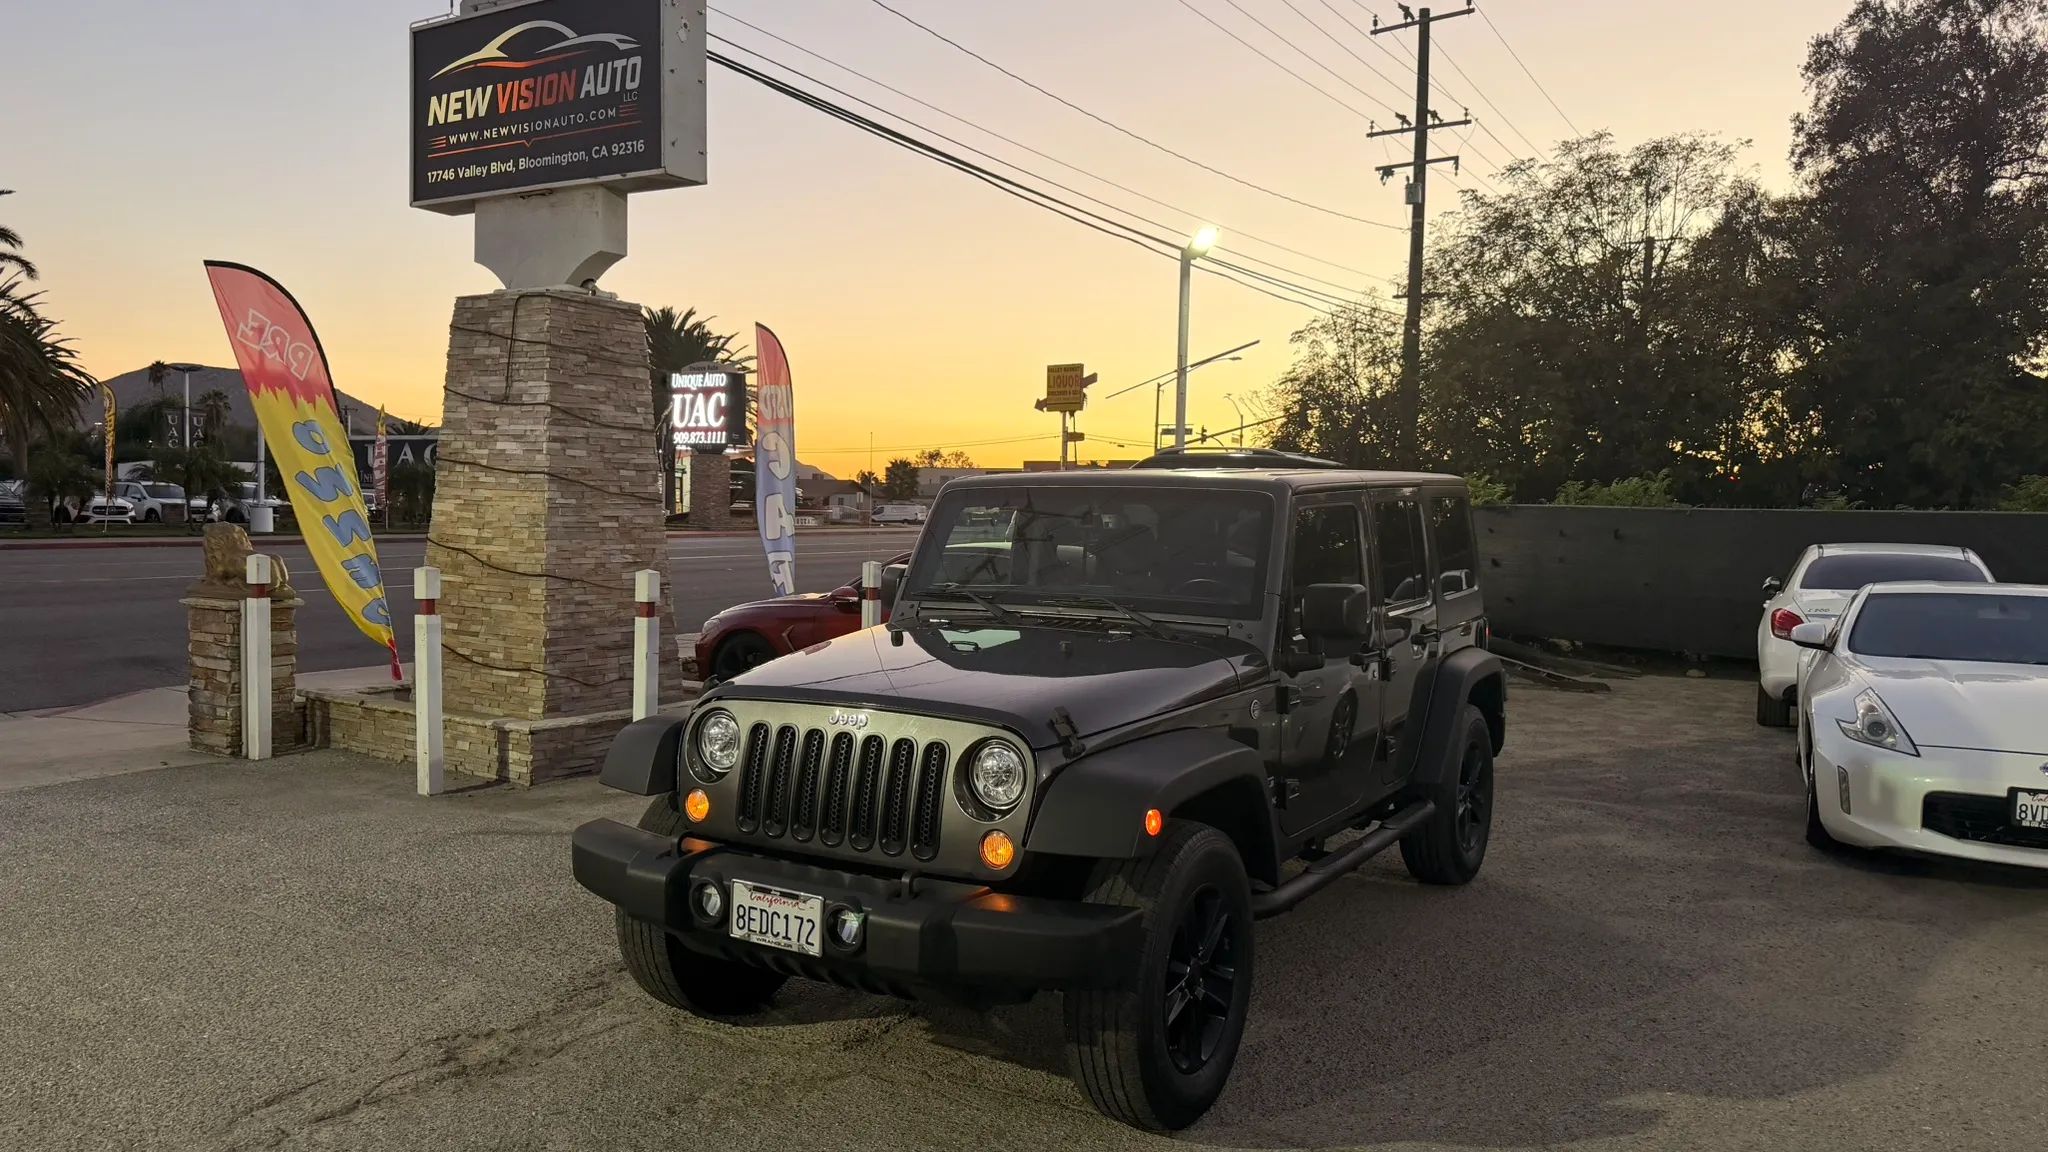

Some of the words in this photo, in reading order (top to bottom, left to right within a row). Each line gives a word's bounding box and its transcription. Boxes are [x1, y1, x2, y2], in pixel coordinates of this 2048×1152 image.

[427, 84, 493, 126] NEW
[496, 68, 577, 114] VISION
[580, 56, 642, 99] AUTO
[623, 91, 638, 102] LLC
[449, 107, 616, 145] WWW.NEWVISIONAUTO.COM
[427, 168, 455, 183] 17746
[457, 164, 488, 179] Valley
[490, 159, 516, 174] Blvd,
[518, 150, 589, 170] Bloomington,
[592, 146, 608, 159] CA
[611, 139, 645, 155] 92316
[672, 373, 703, 390] UNIQUE
[703, 372, 726, 387] AUTO
[1048, 374, 1080, 388] LIQUOR
[672, 391, 726, 428] UAC
[673, 431, 726, 443] 909.873.1111
[829, 709, 868, 730] Jeep
[736, 904, 815, 946] 8EDC172
